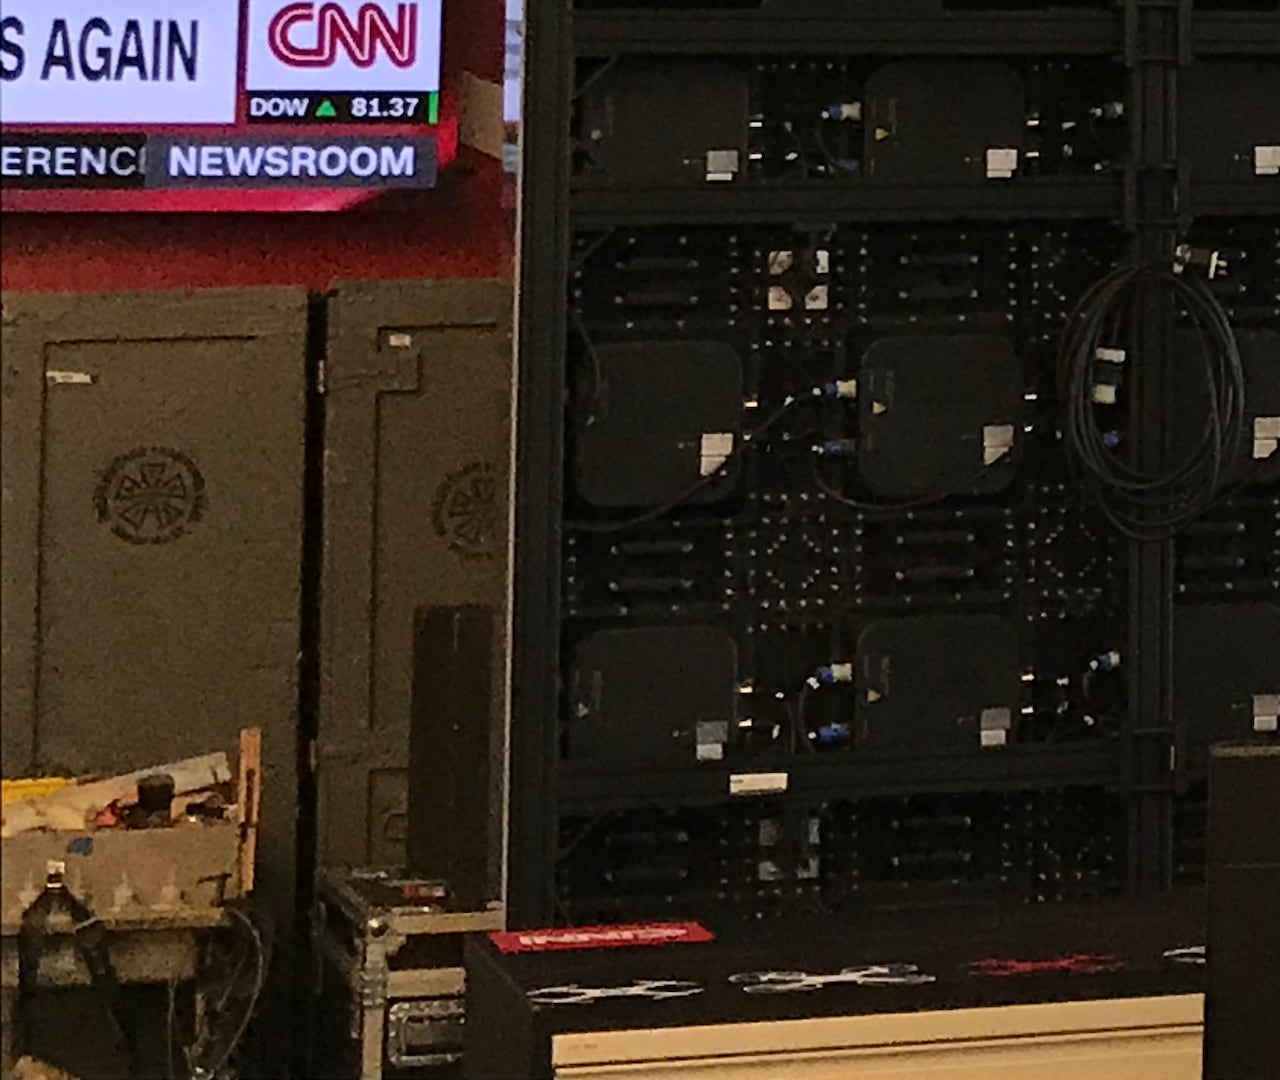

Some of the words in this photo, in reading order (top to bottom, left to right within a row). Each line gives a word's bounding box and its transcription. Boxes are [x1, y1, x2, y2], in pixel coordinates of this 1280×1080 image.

[40, 17, 199, 82] AGAIN
[268, 2, 418, 69] CNN
[250, 98, 309, 117] DOW
[351, 98, 419, 117] 81.37
[169, 145, 416, 177] NEWSROOM
